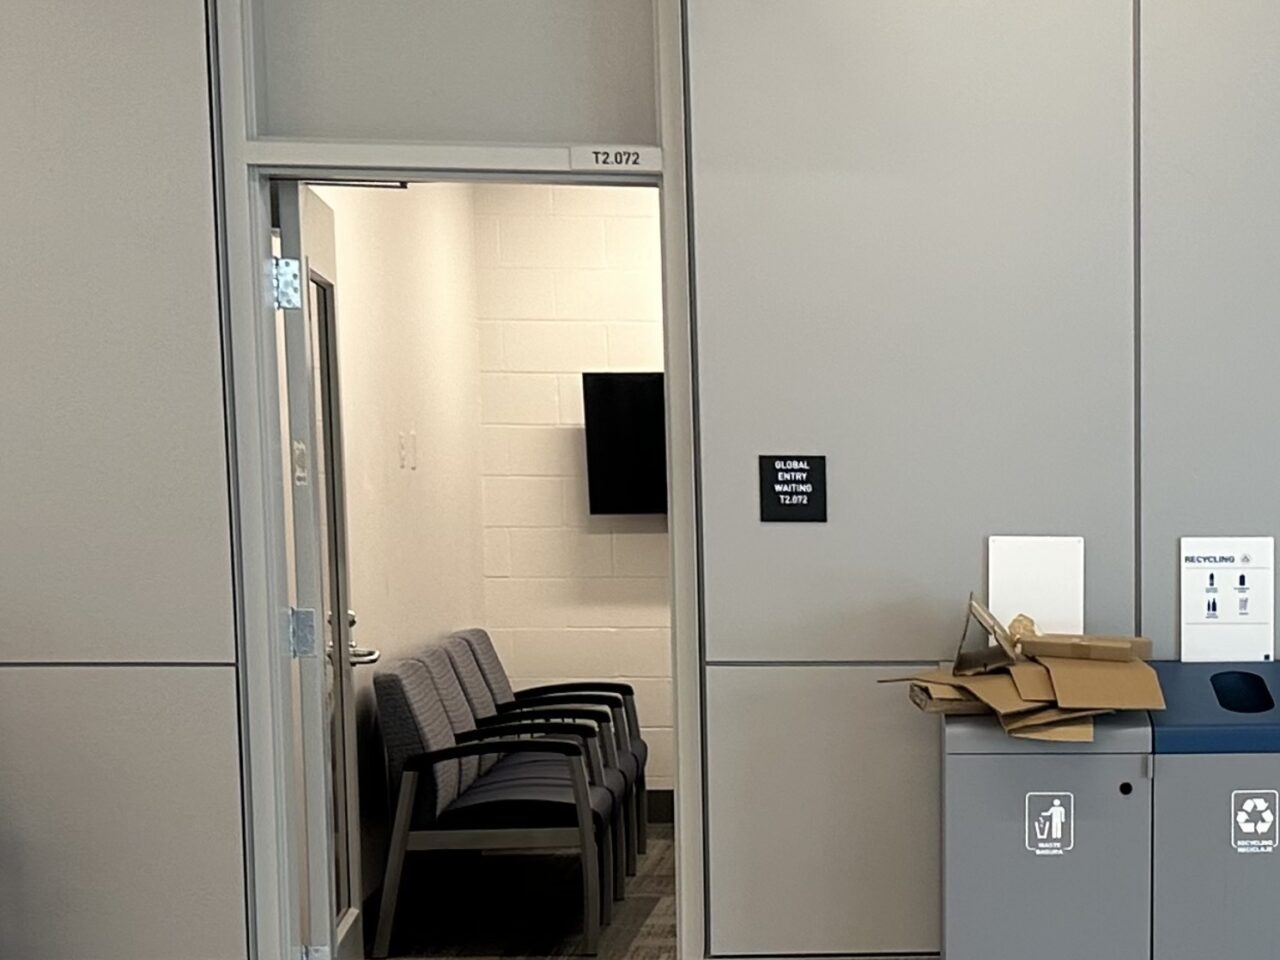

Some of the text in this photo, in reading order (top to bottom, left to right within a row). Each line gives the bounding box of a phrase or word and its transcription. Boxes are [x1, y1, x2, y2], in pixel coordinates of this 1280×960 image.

[592, 151, 641, 165] T2.072
[774, 460, 810, 470] GLOBAL
[777, 471, 807, 481] ENTRY
[774, 483, 813, 493] WAITING
[779, 494, 808, 504] T2.072
[1184, 555, 1235, 564] RECYCLING
